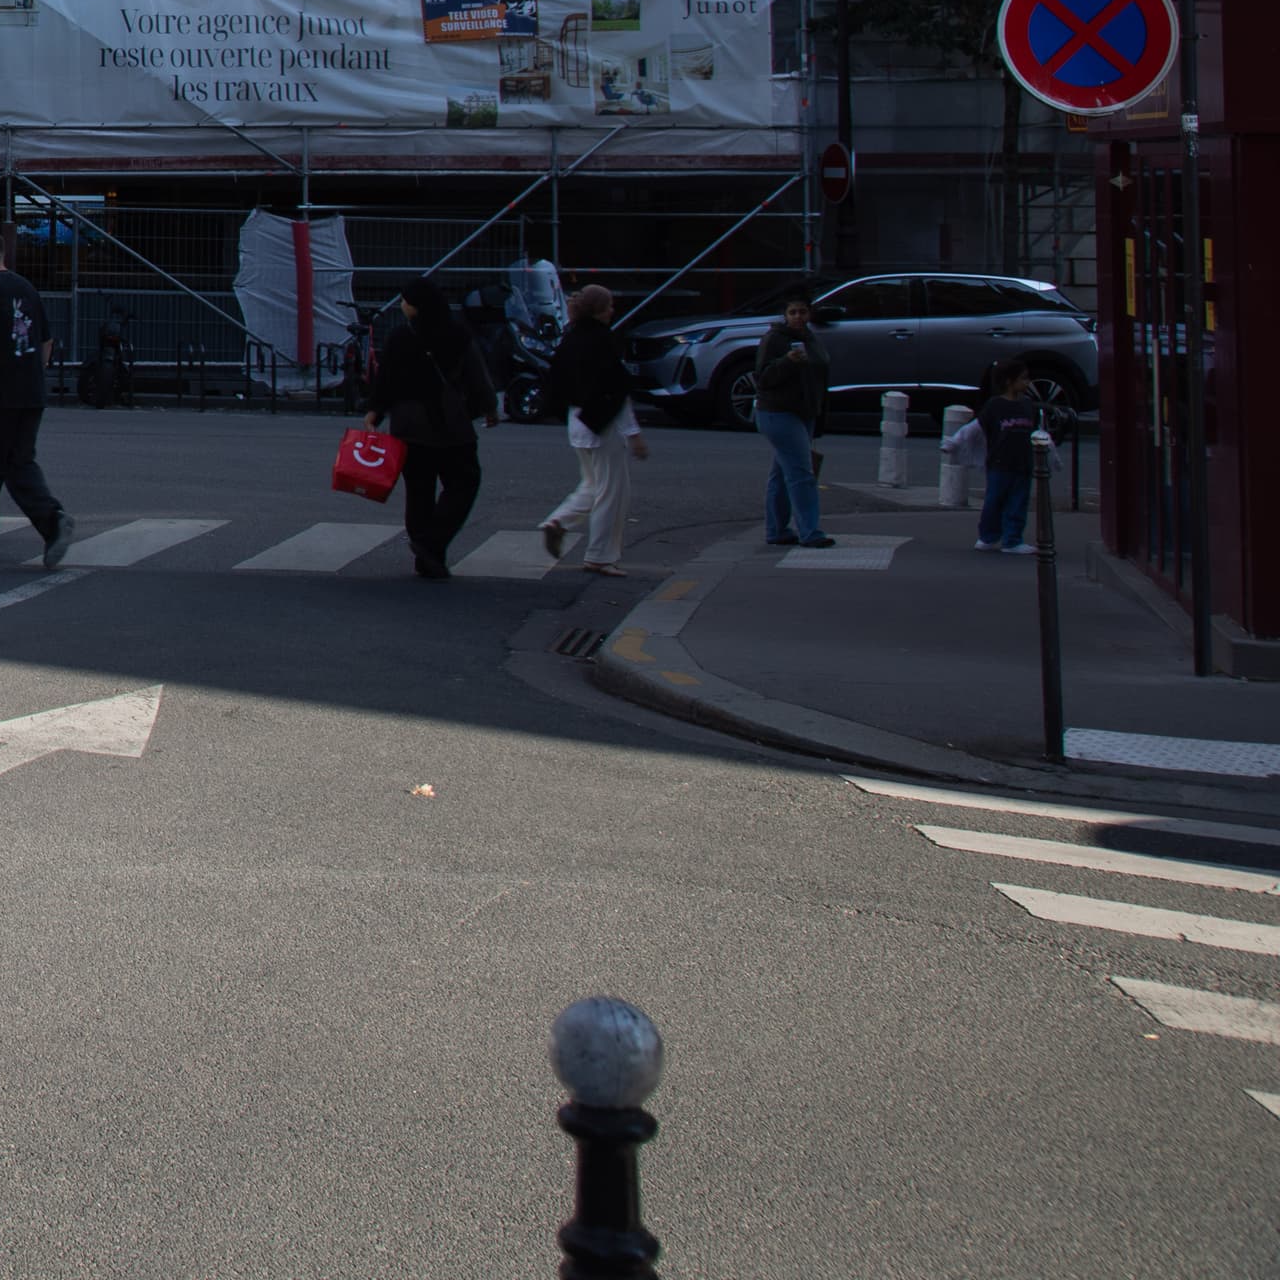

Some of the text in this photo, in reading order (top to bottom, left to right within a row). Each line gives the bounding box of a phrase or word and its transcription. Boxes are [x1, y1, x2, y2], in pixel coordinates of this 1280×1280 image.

[120, 8, 368, 42] Votre agence Junot
[441, 19, 508, 32] SURVEILLANCE
[98, 43, 391, 76] reste ouverte pendant
[172, 75, 318, 102] les travaux
